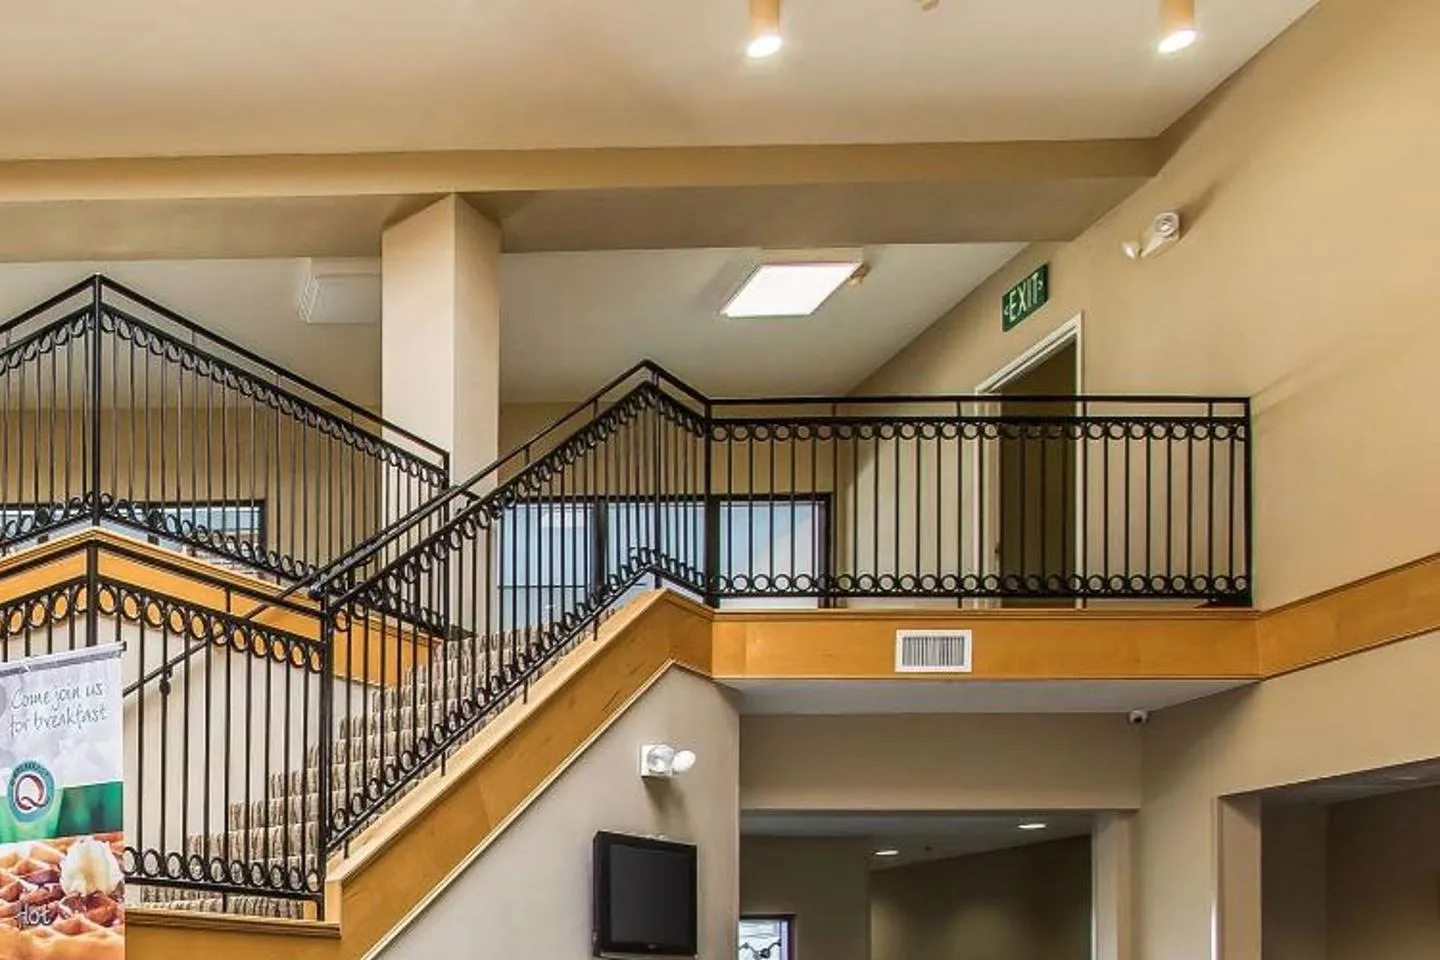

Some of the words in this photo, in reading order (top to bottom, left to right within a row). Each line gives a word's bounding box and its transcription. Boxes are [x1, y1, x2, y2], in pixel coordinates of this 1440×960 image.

[1009, 271, 1039, 323] EXIT
[11, 688, 50, 709] Come
[51, 682, 81, 711] join
[86, 683, 103, 698] us
[10, 714, 29, 738] for
[34, 704, 108, 730] breakfast
[14, 773, 49, 811] Q
[16, 902, 51, 927] Hot
